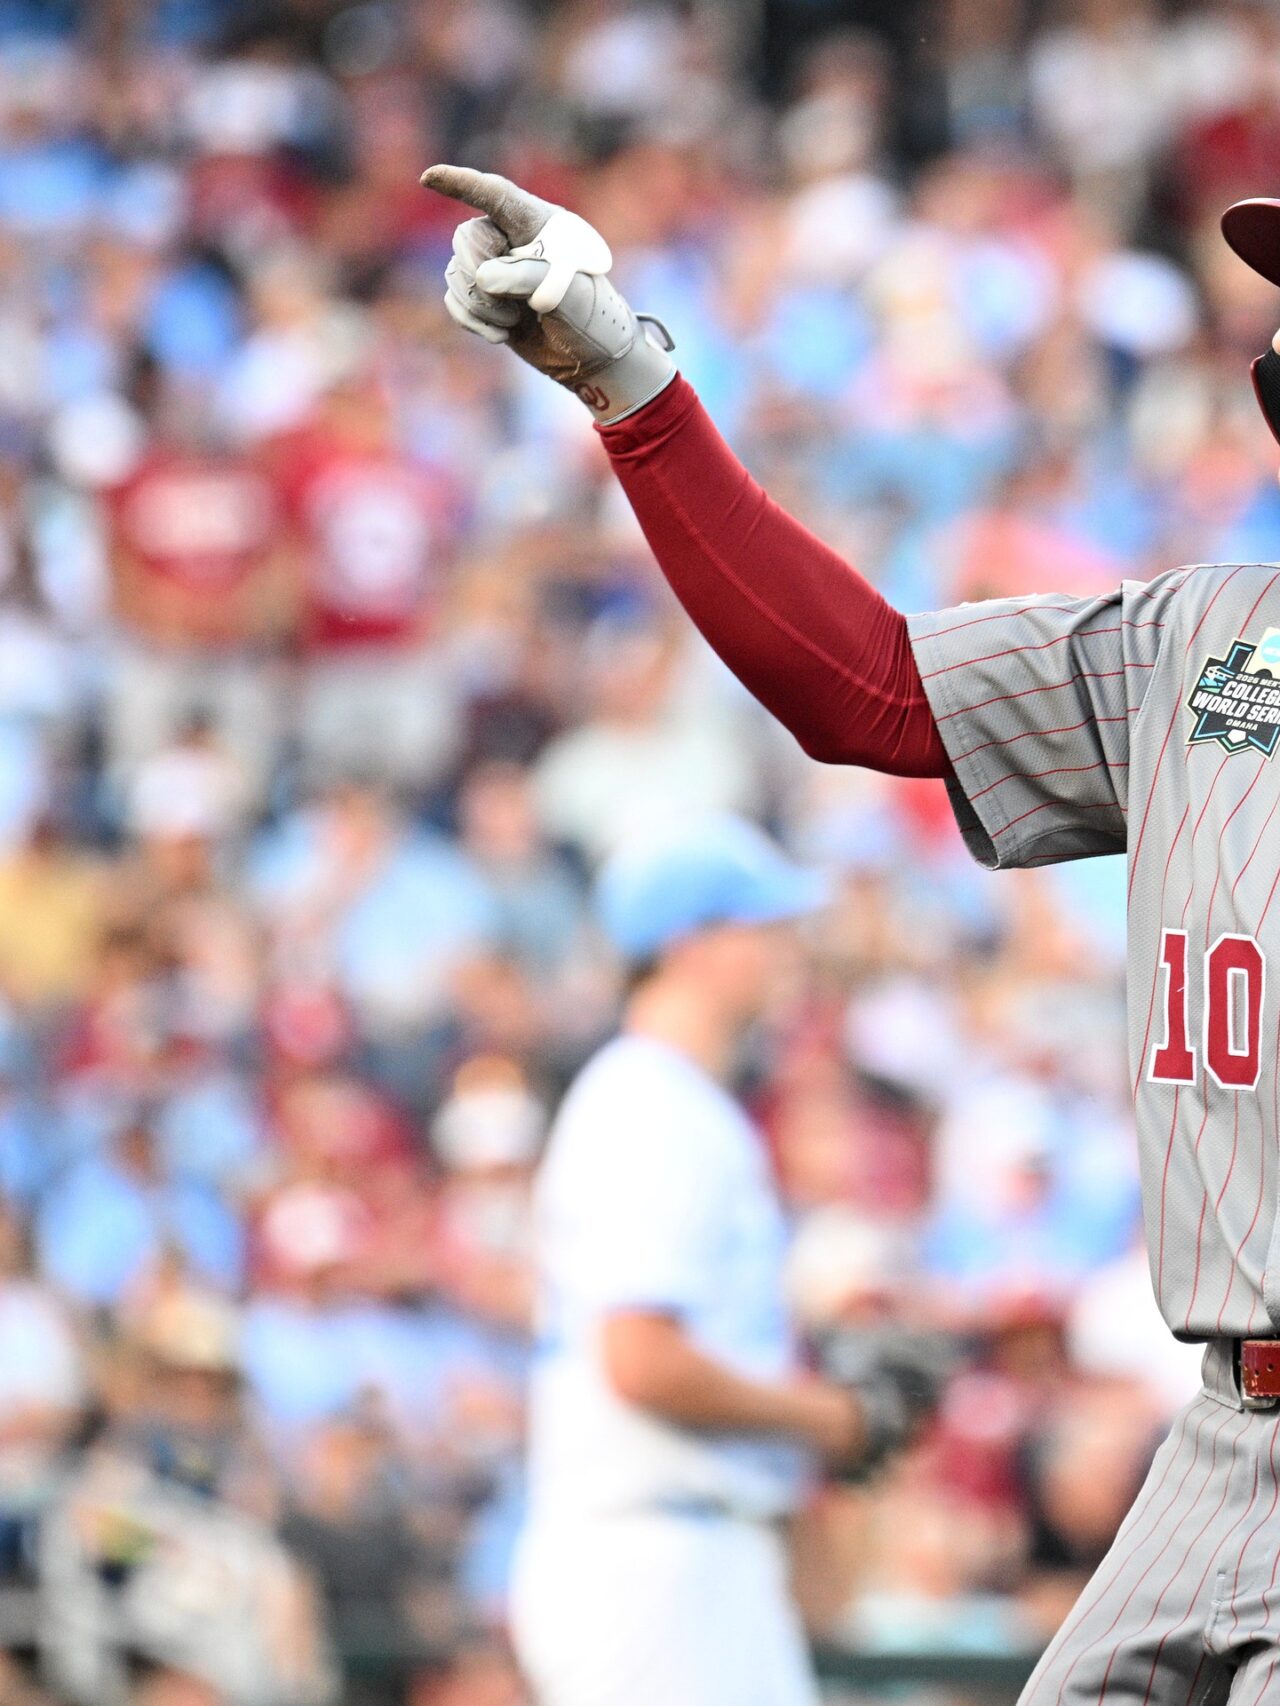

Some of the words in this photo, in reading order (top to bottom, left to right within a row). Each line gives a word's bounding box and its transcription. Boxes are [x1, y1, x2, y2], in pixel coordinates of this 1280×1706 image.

[1192, 691, 1248, 718] WORLD
[1225, 719, 1258, 731] OMAHA
[1146, 928, 1266, 1091] 10
